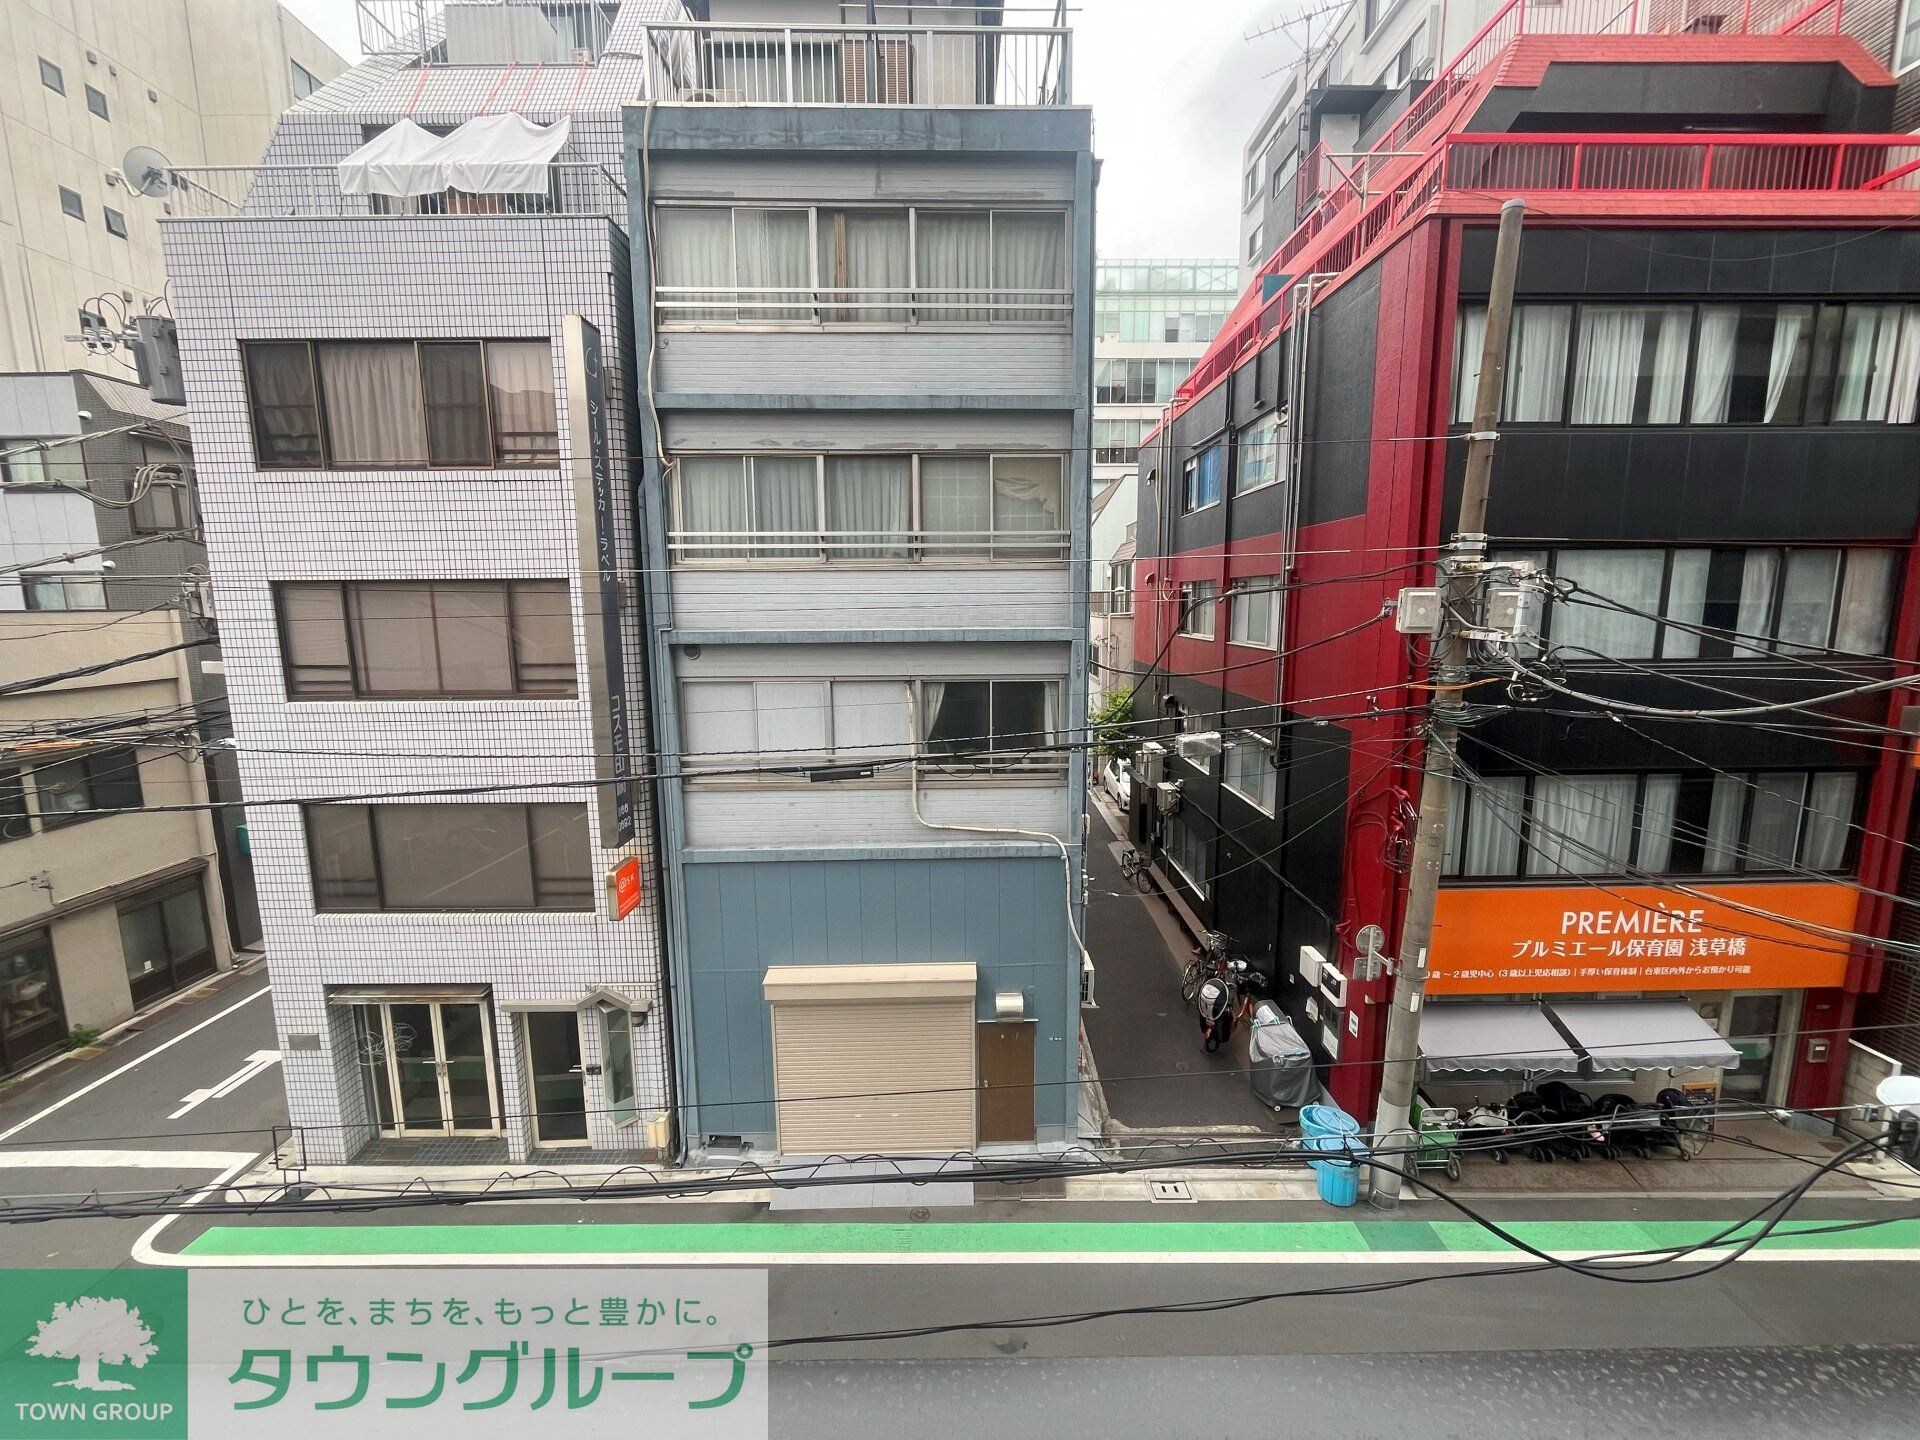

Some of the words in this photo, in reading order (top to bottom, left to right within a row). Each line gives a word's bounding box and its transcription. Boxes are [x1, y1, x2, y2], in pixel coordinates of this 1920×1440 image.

[589, 399, 611, 583] シール・ステッカー・ラベル
[1561, 902, 1704, 935] PREMIÈRE
[1512, 938, 1684, 958] プルミエール保育園
[1689, 938, 1747, 956] 浅草橋
